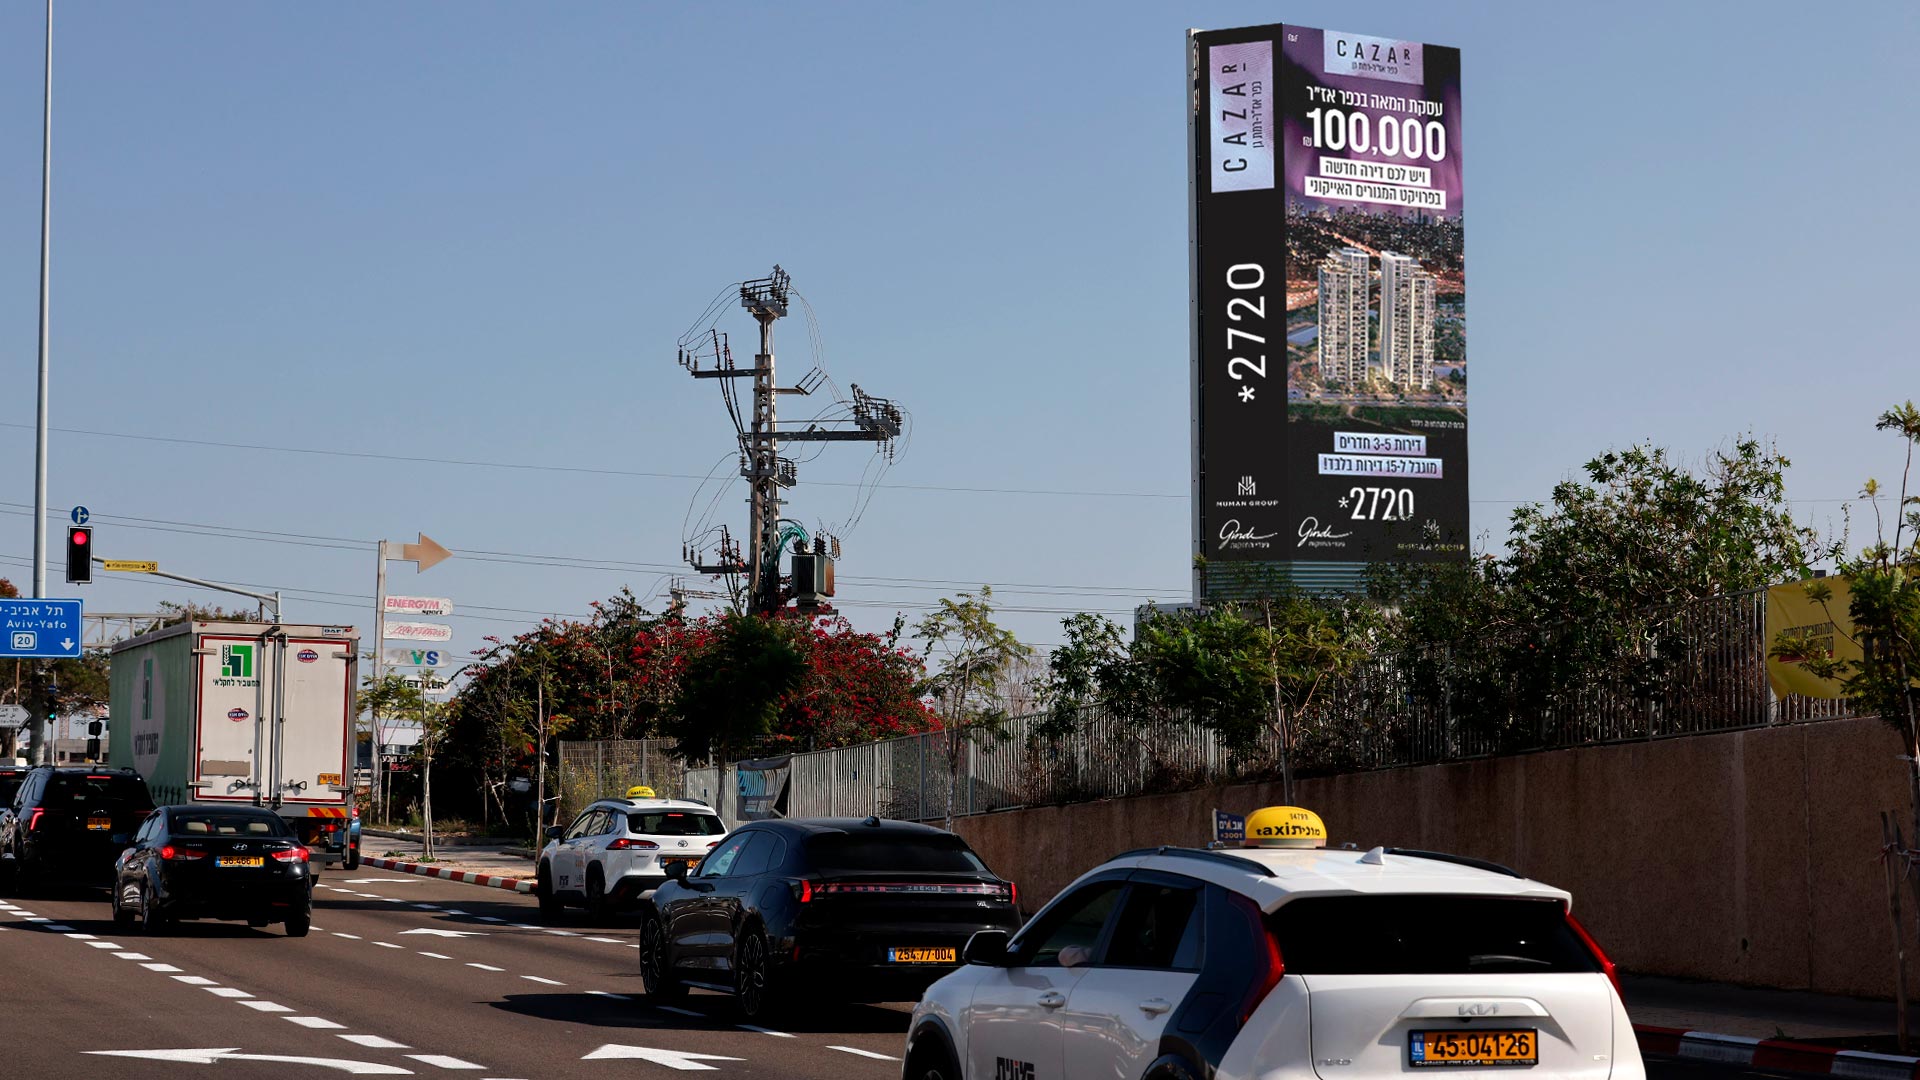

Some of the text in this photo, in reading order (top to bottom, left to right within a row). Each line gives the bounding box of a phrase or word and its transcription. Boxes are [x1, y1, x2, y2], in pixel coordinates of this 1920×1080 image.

[1336, 39, 1411, 66] CAZAR
[1252, 81, 1262, 97] כפר
[1338, 90, 1369, 107] בכפר
[1370, 94, 1406, 112] המאה
[1408, 99, 1443, 117] עסקת
[1222, 63, 1247, 172] CAZAR
[1325, 160, 1426, 183] ויש לכם דירה חדשה
[1310, 179, 1442, 205] בפרויקט המגורים האייקוני
[1339, 435, 1371, 450] חדרים
[1394, 438, 1422, 452] דירות
[1323, 456, 1354, 471] בלבד!
[1356, 458, 1383, 473] דירות
[1408, 460, 1438, 475] מוגבל
[1249, 499, 1279, 507] GROUP
[45, 604, 64, 616] תל
[386, 598, 440, 609] ENERGYM
[6, 619, 67, 629] Aviv-Yafo
[17, 636, 31, 645] 20
[1255, 822, 1321, 836] taxi מונית
